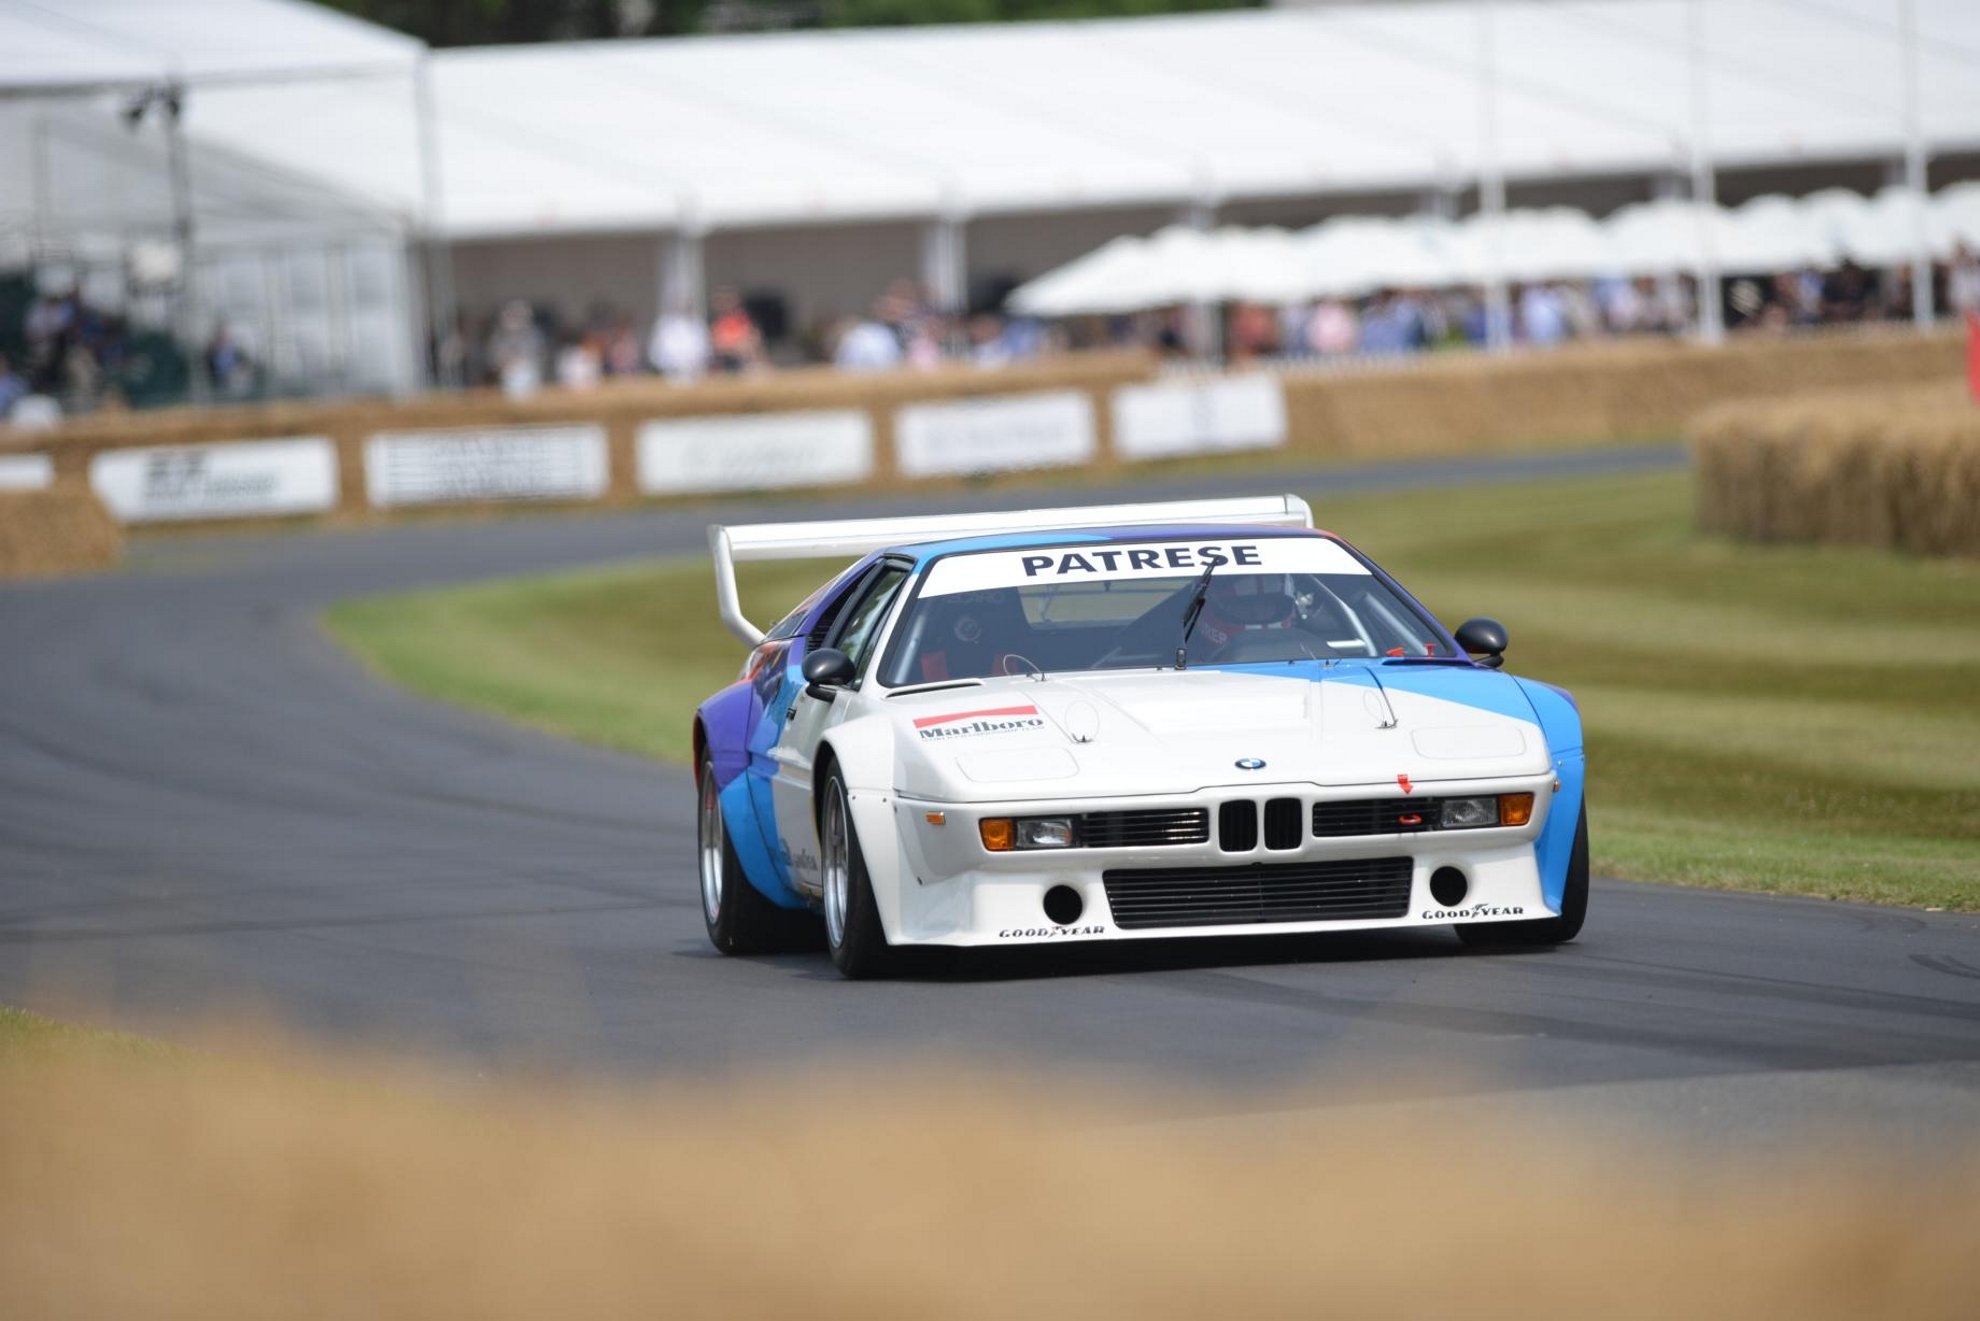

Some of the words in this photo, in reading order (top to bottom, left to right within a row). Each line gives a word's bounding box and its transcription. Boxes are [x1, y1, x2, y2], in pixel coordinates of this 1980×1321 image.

[1021, 546, 1262, 576] PATRESE
[919, 719, 1044, 739] Marlboro
[1422, 905, 1524, 919] GOODYEAR
[999, 926, 1105, 938] GOODYEAR
